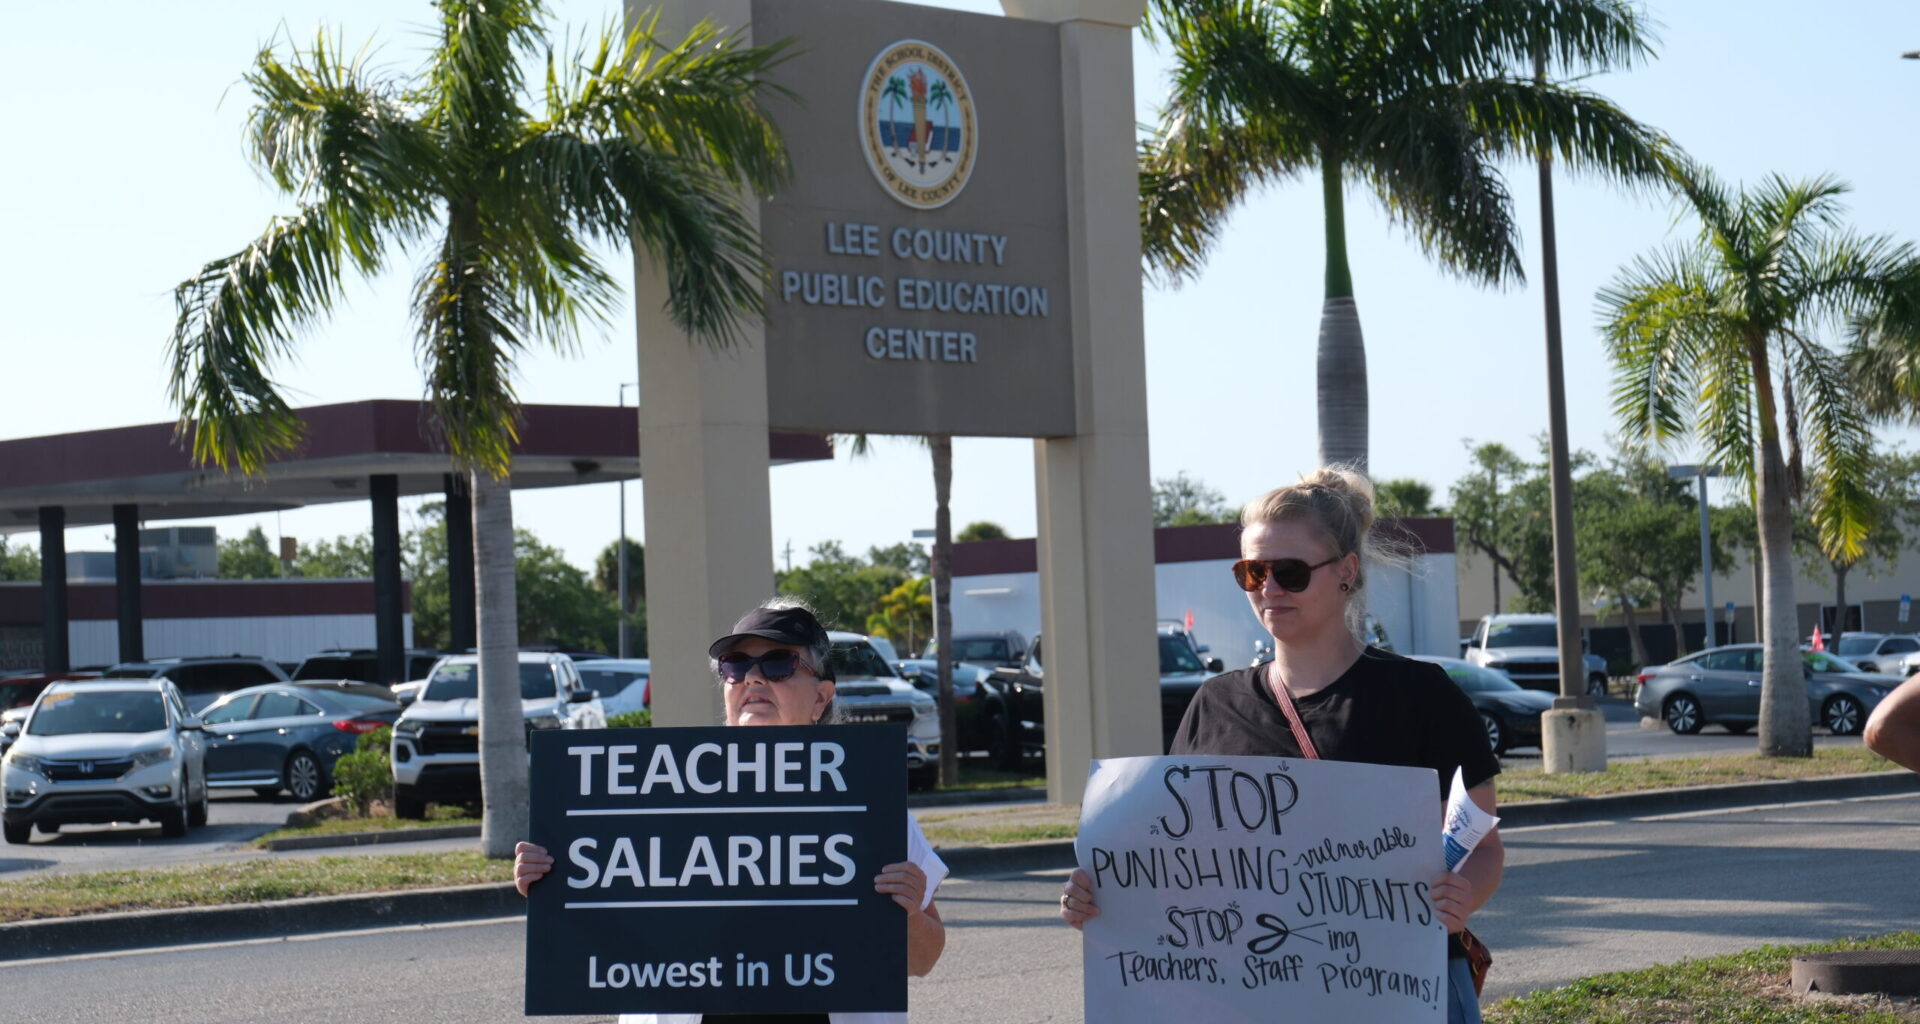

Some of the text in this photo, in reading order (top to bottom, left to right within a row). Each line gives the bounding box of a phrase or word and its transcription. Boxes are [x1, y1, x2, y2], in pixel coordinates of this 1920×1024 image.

[870, 47, 967, 100] THE SCHOOL DISTRICT
[883, 166, 960, 201] OF LEE COUNTY
[826, 221, 1008, 266] LEE COUNTY
[782, 271, 1049, 317] PUBLIC EDUCATION
[865, 327, 978, 363] CENTER
[567, 742, 848, 796] TEACHER
[1160, 764, 1299, 839] STOP
[567, 834, 857, 889] SALARIES
[1092, 847, 1290, 896] PUNISHING
[1294, 826, 1417, 869] vulnerable
[1166, 906, 1361, 964] STOP ing
[588, 953, 836, 989] Lowest in US
[1242, 954, 1304, 989] Staff
[1316, 962, 1441, 1011] Programs!
